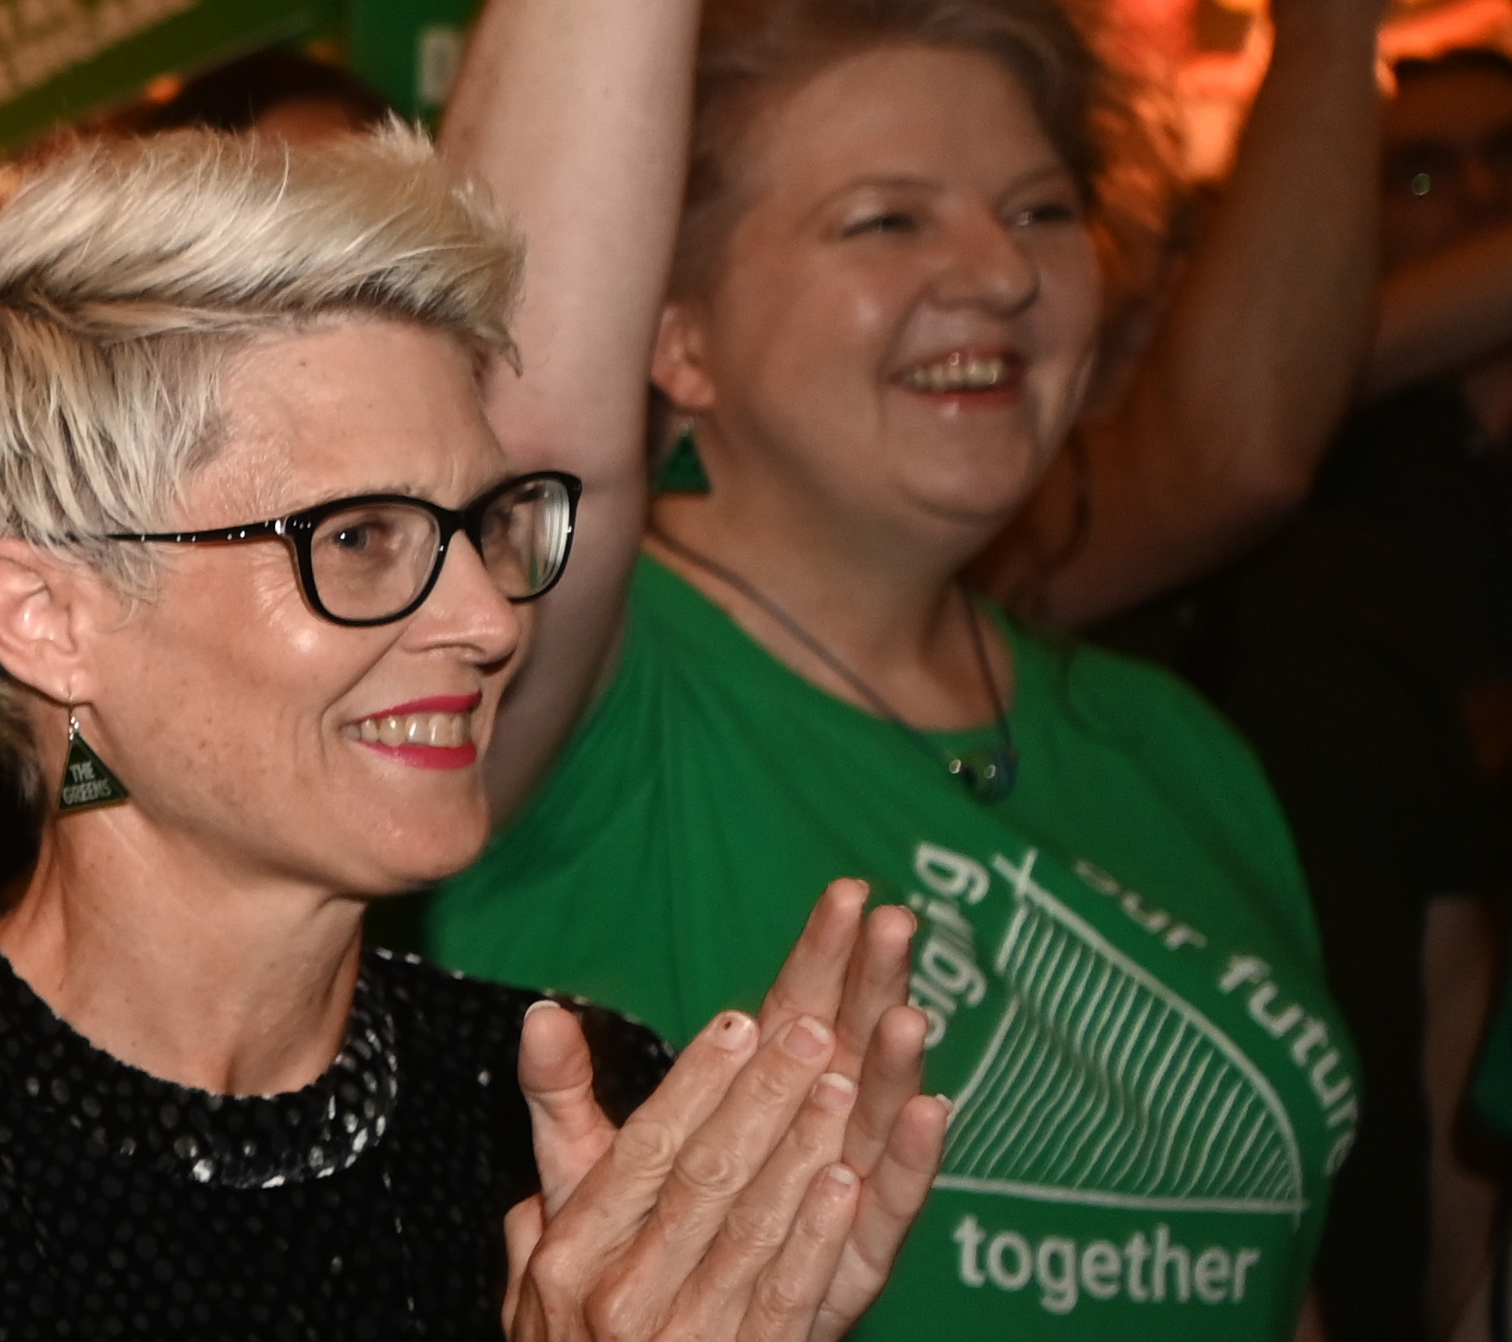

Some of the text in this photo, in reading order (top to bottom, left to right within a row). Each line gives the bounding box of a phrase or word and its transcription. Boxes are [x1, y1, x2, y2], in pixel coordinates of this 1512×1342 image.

[68, 761, 96, 783] THE
[62, 779, 113, 805] GREENS
[953, 1213, 1260, 1315] together
